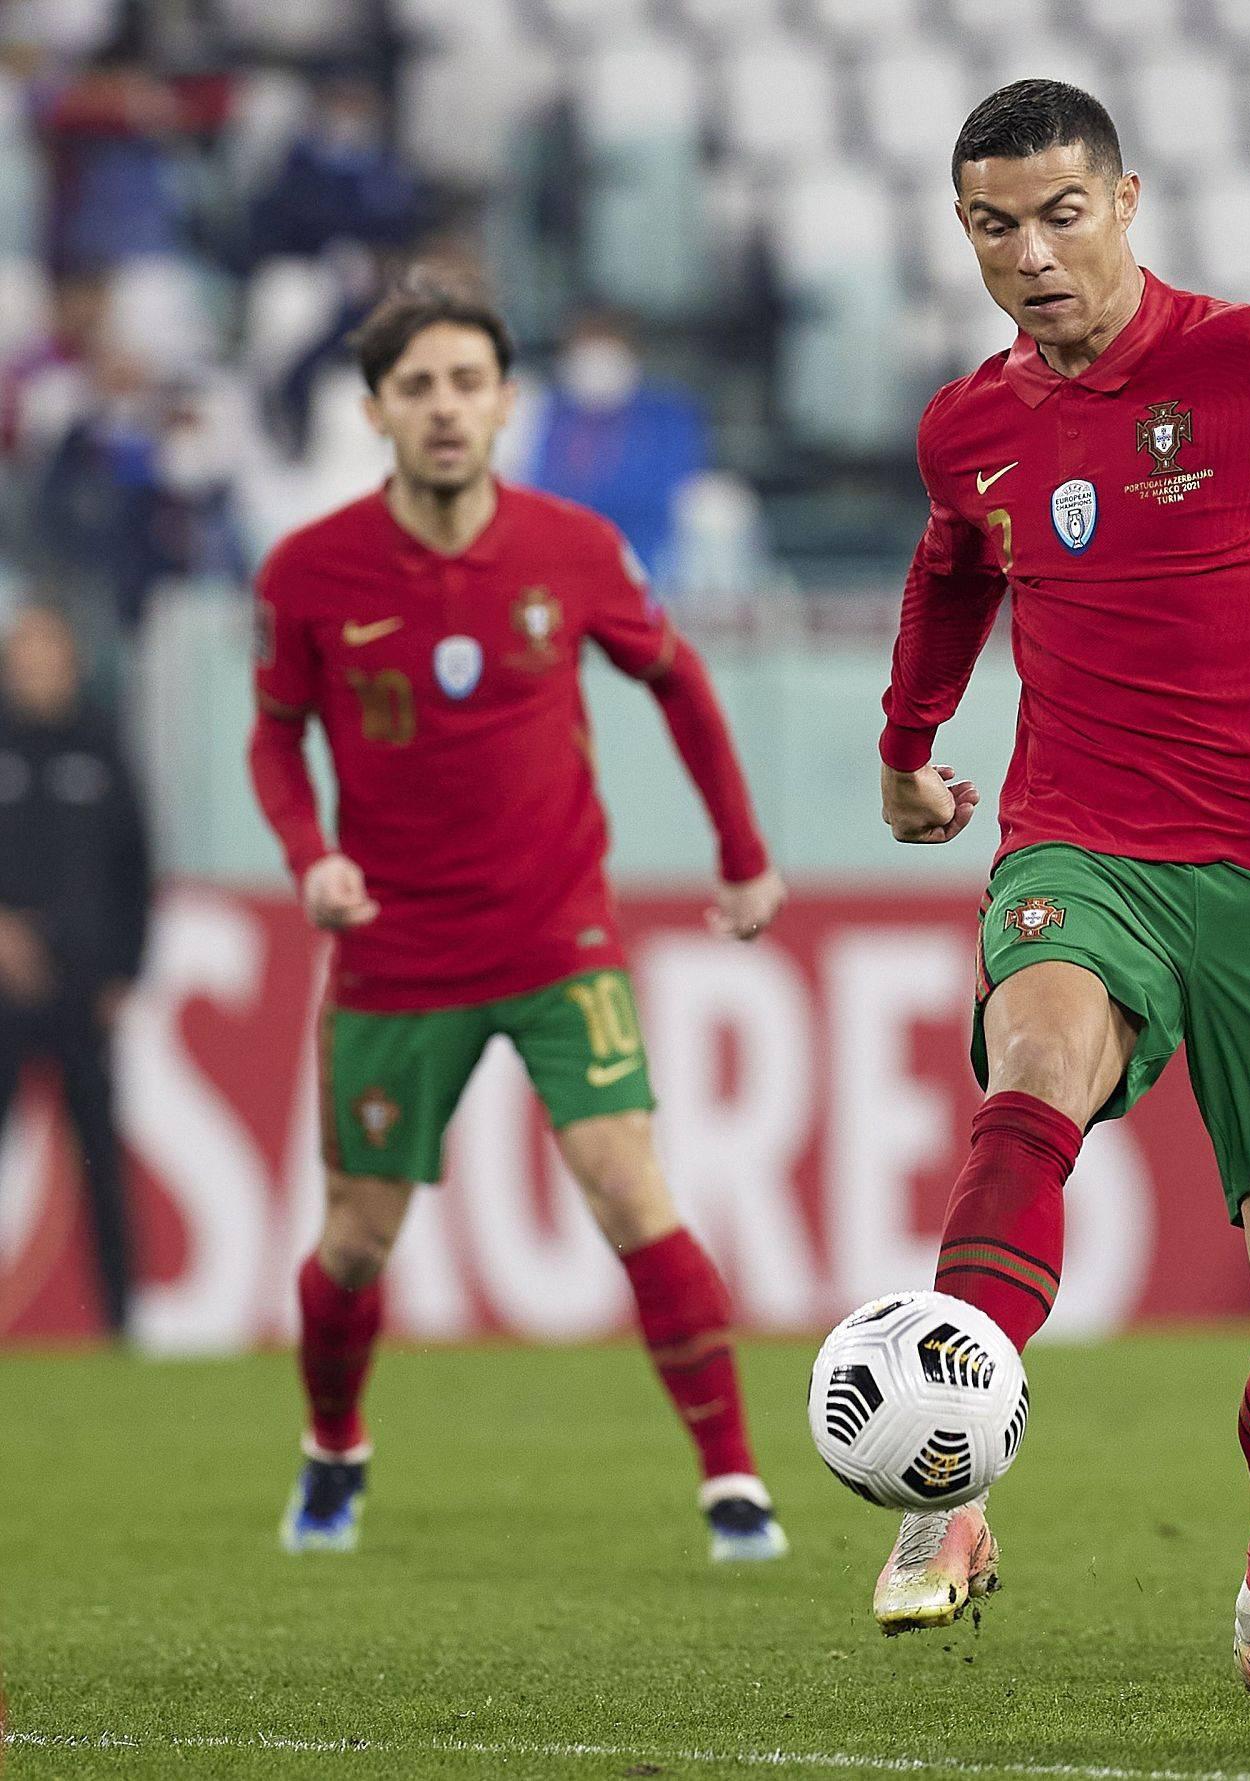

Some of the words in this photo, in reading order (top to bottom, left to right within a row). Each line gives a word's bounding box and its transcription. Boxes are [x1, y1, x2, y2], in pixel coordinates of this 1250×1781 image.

[1182, 480, 1201, 492] 2021
[1055, 492, 1092, 505] EUROPEAN
[1156, 493, 1185, 505] TURIM
[1055, 499, 1092, 511] CHAMPIONS
[346, 669, 417, 748] 10
[568, 972, 641, 1059] 10
